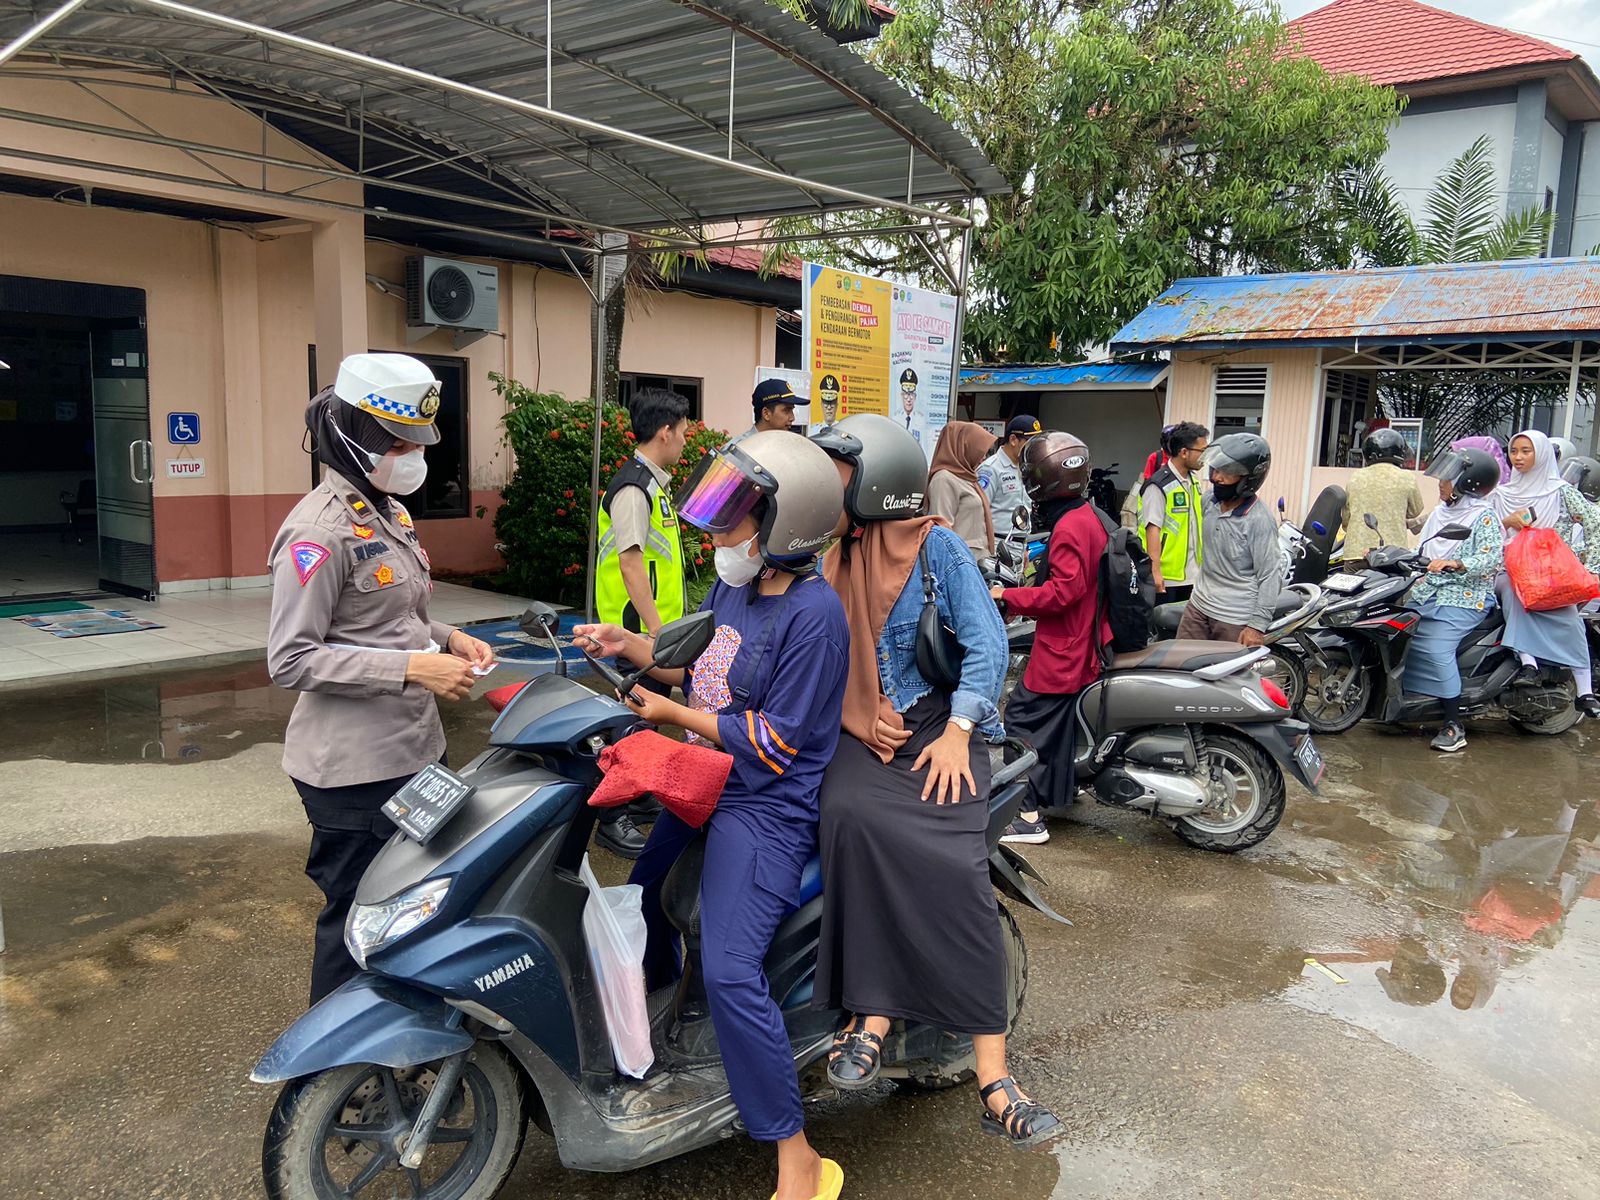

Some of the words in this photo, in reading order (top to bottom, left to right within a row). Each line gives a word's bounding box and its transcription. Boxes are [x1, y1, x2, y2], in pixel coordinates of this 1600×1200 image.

[820, 295, 851, 310] PEMBEBASAN
[852, 302, 872, 314] DENDA
[825, 309, 857, 325] PENGURANGAN
[860, 317, 878, 326] PAJAK
[897, 313, 912, 331] AYO
[912, 314, 923, 332] KE
[923, 316, 951, 338] SAMSAT
[820, 322, 848, 336] KENDARAAN
[847, 326, 872, 340] BERMOTOR
[170, 463, 201, 473] TUTUP
[883, 494, 912, 511] Classic
[787, 537, 823, 551] Classic
[1367, 607, 1390, 616] HONDA
[1174, 705, 1244, 713] SCOOPY
[411, 771, 435, 791] KT
[420, 777, 451, 803] 3055
[437, 787, 461, 810] SY
[474, 952, 535, 993] YAMAHA
